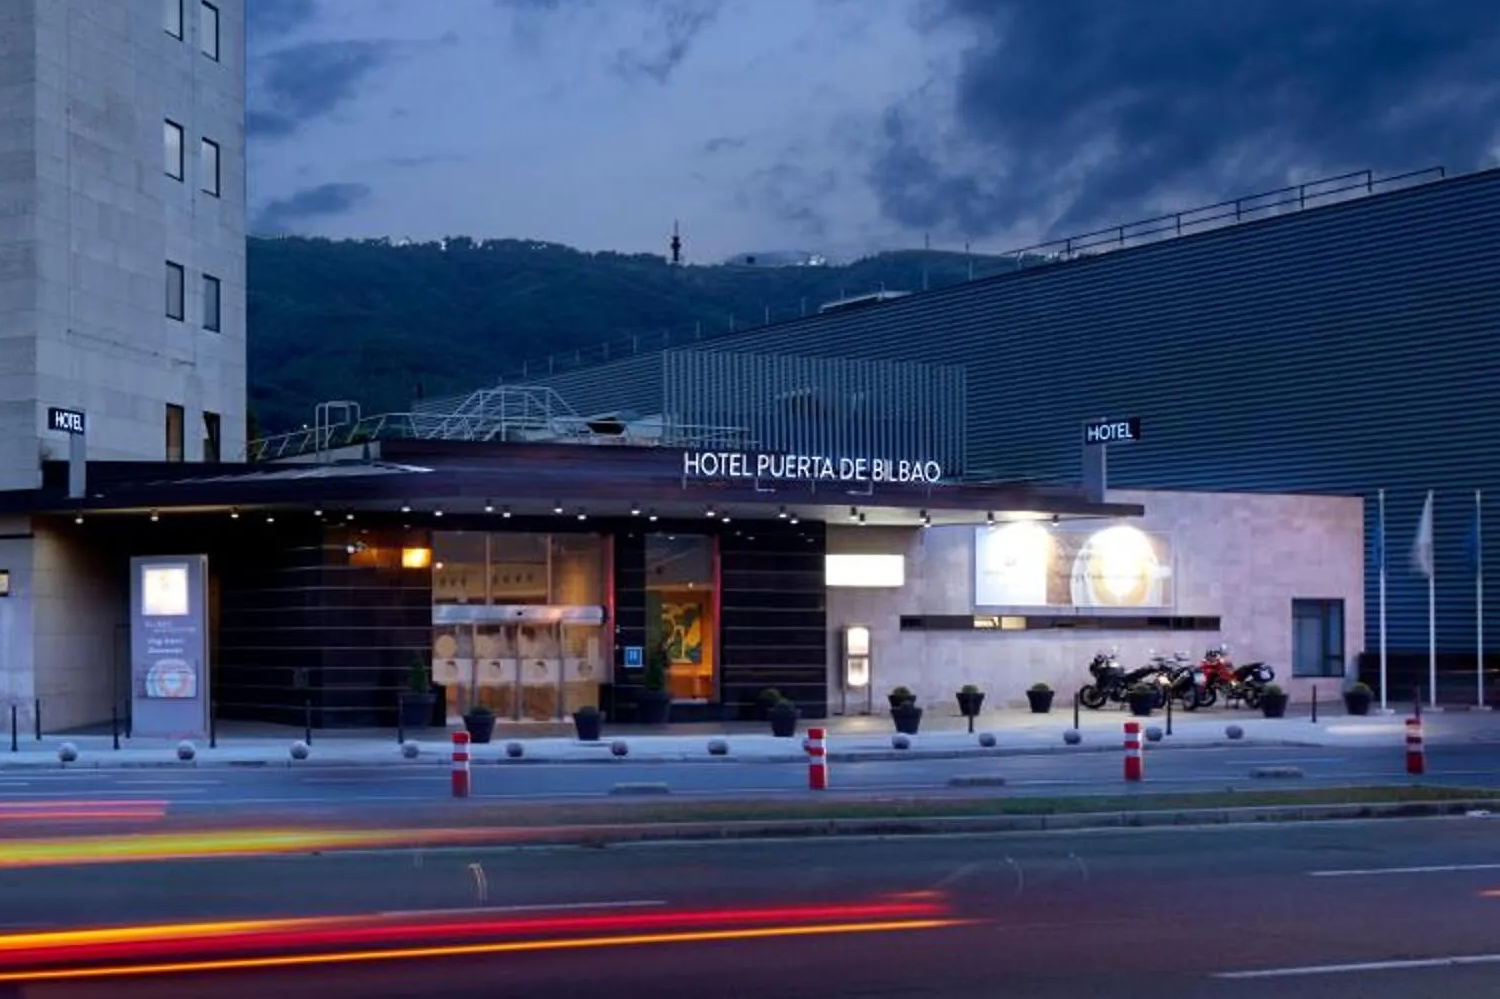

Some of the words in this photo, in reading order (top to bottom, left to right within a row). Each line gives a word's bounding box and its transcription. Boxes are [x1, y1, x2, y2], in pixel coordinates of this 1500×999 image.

[55, 410, 83, 431] HOTEL
[1087, 422, 1133, 442] HOTEL
[683, 451, 753, 477] HOTEL
[756, 453, 836, 480] PUERTA
[839, 457, 869, 481] DE
[871, 458, 942, 483] BILBAO
